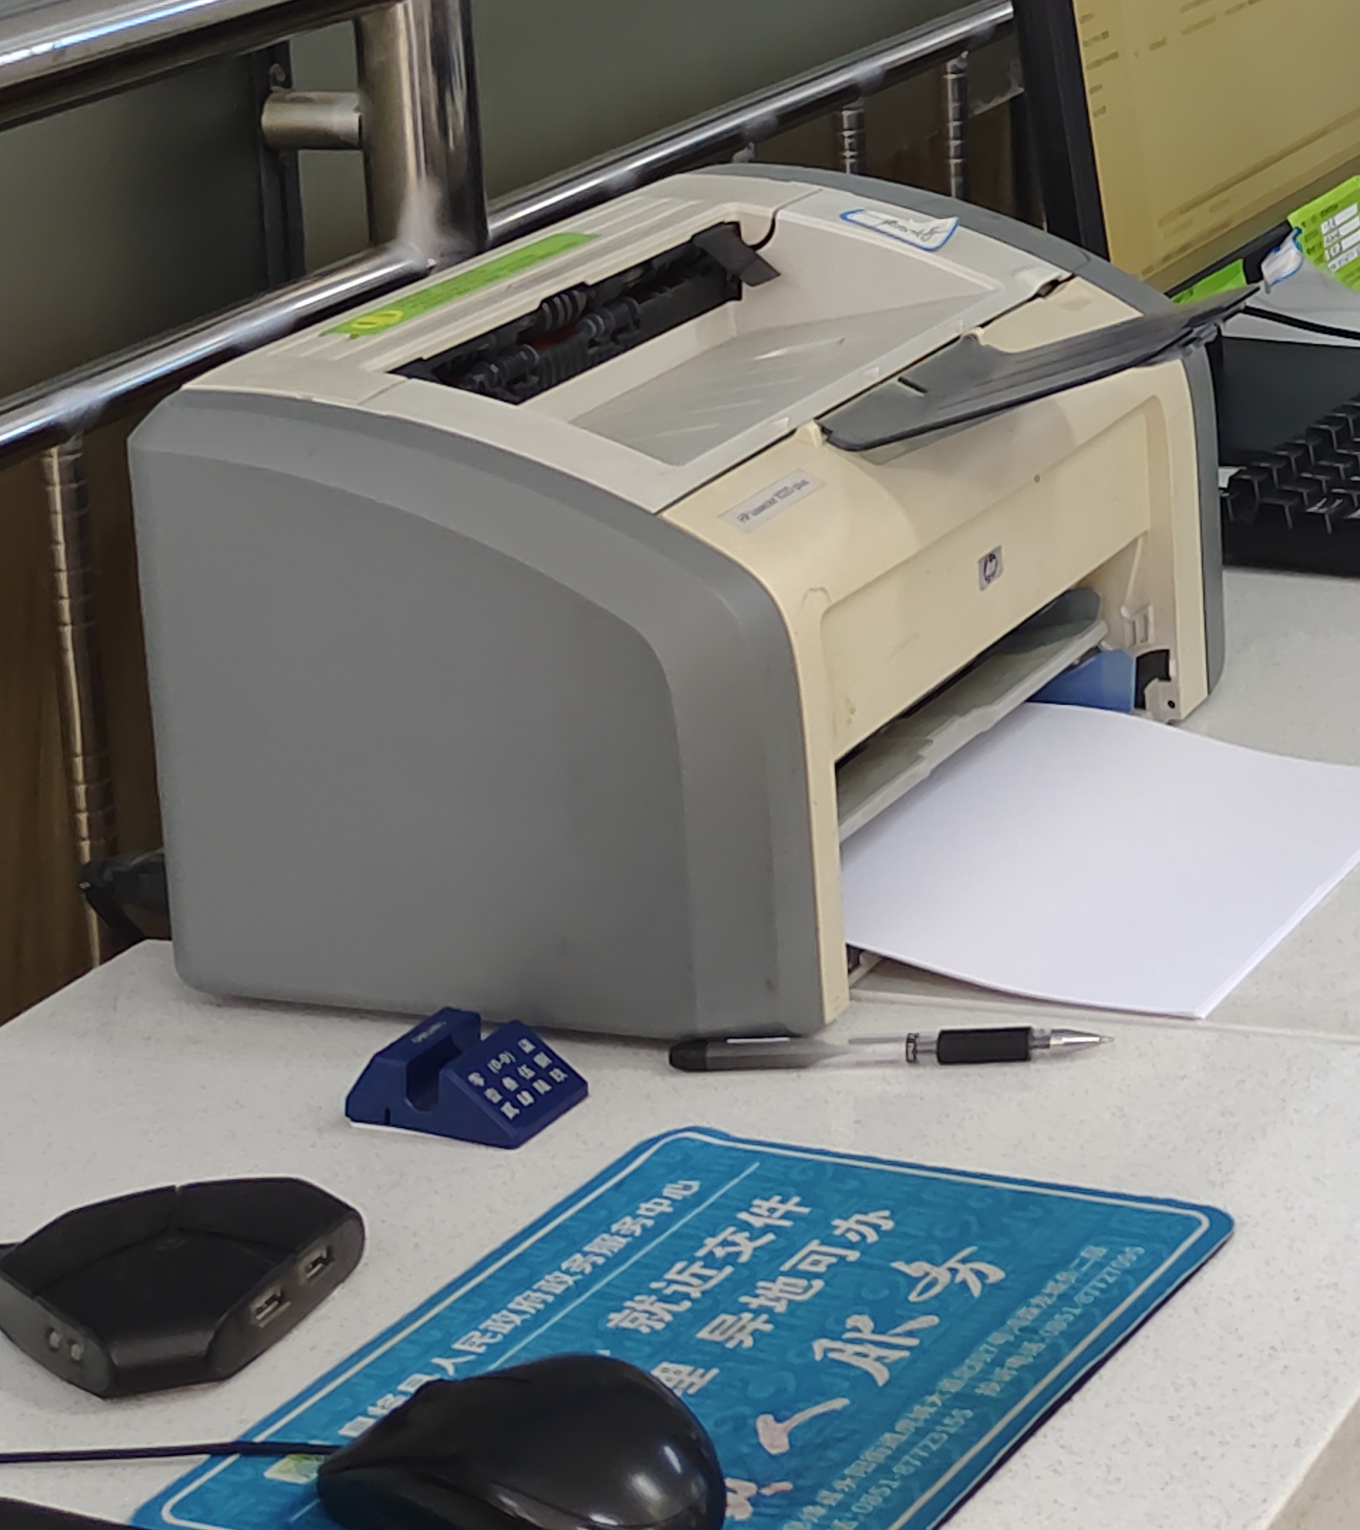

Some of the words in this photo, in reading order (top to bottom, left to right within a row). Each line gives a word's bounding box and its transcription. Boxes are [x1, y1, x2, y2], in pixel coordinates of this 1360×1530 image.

[606, 1194, 812, 1334] 就近交件
[694, 1209, 896, 1350] 异地可办
